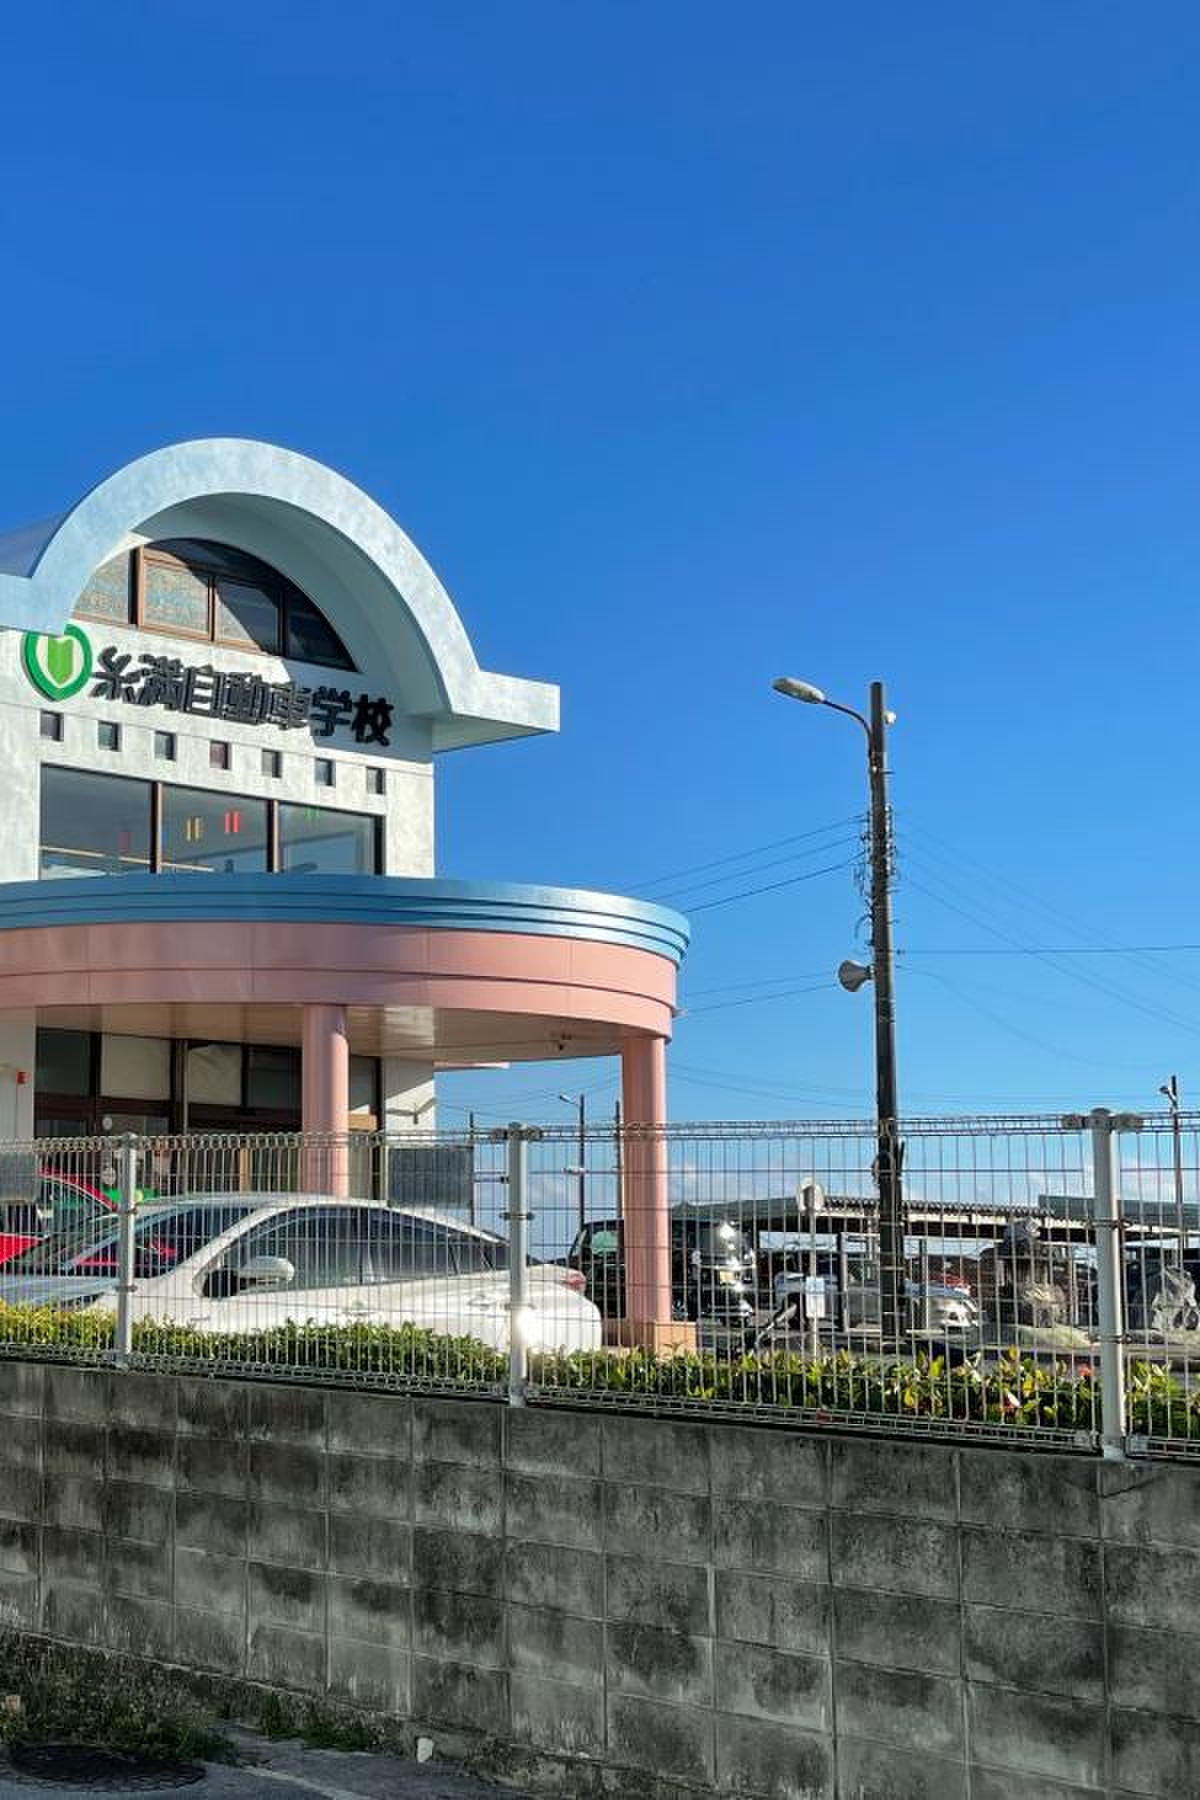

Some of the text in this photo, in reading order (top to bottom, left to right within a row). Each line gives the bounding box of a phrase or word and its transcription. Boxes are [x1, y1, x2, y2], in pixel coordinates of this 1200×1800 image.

[88, 646, 395, 747] 糸満自動車学校
